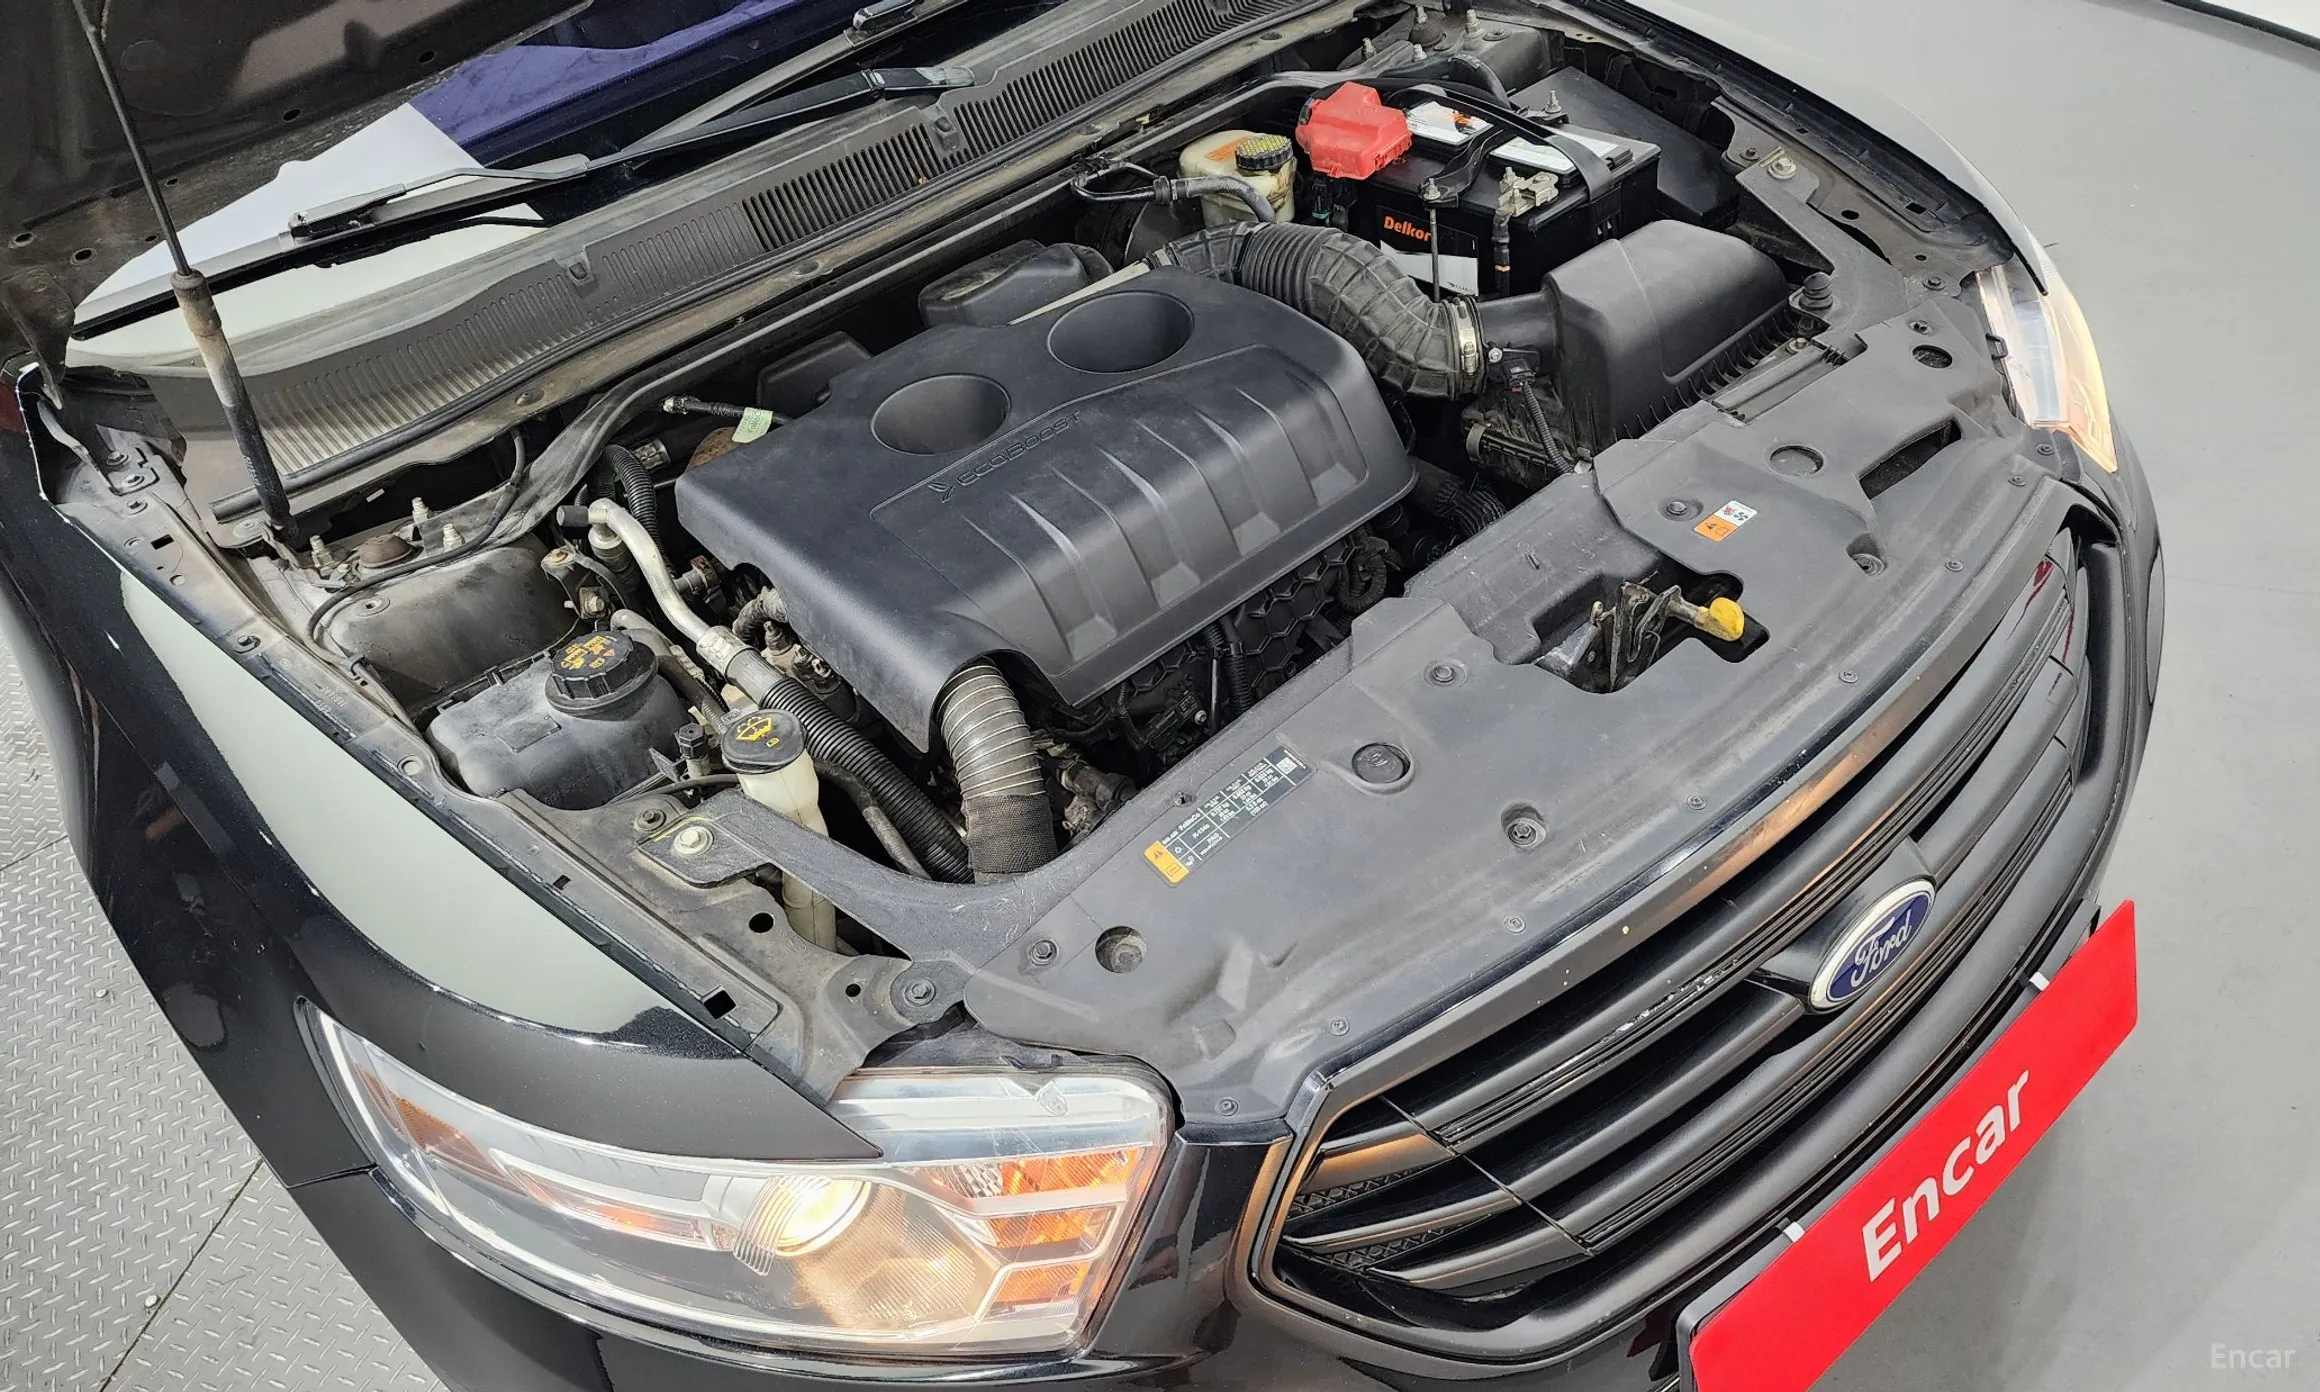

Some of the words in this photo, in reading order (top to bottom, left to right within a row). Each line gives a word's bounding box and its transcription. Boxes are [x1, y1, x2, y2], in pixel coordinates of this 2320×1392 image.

[1383, 215, 1432, 242] Delkor
[1850, 908, 1913, 988] Ford
[1862, 1069, 2030, 1283] Encar
